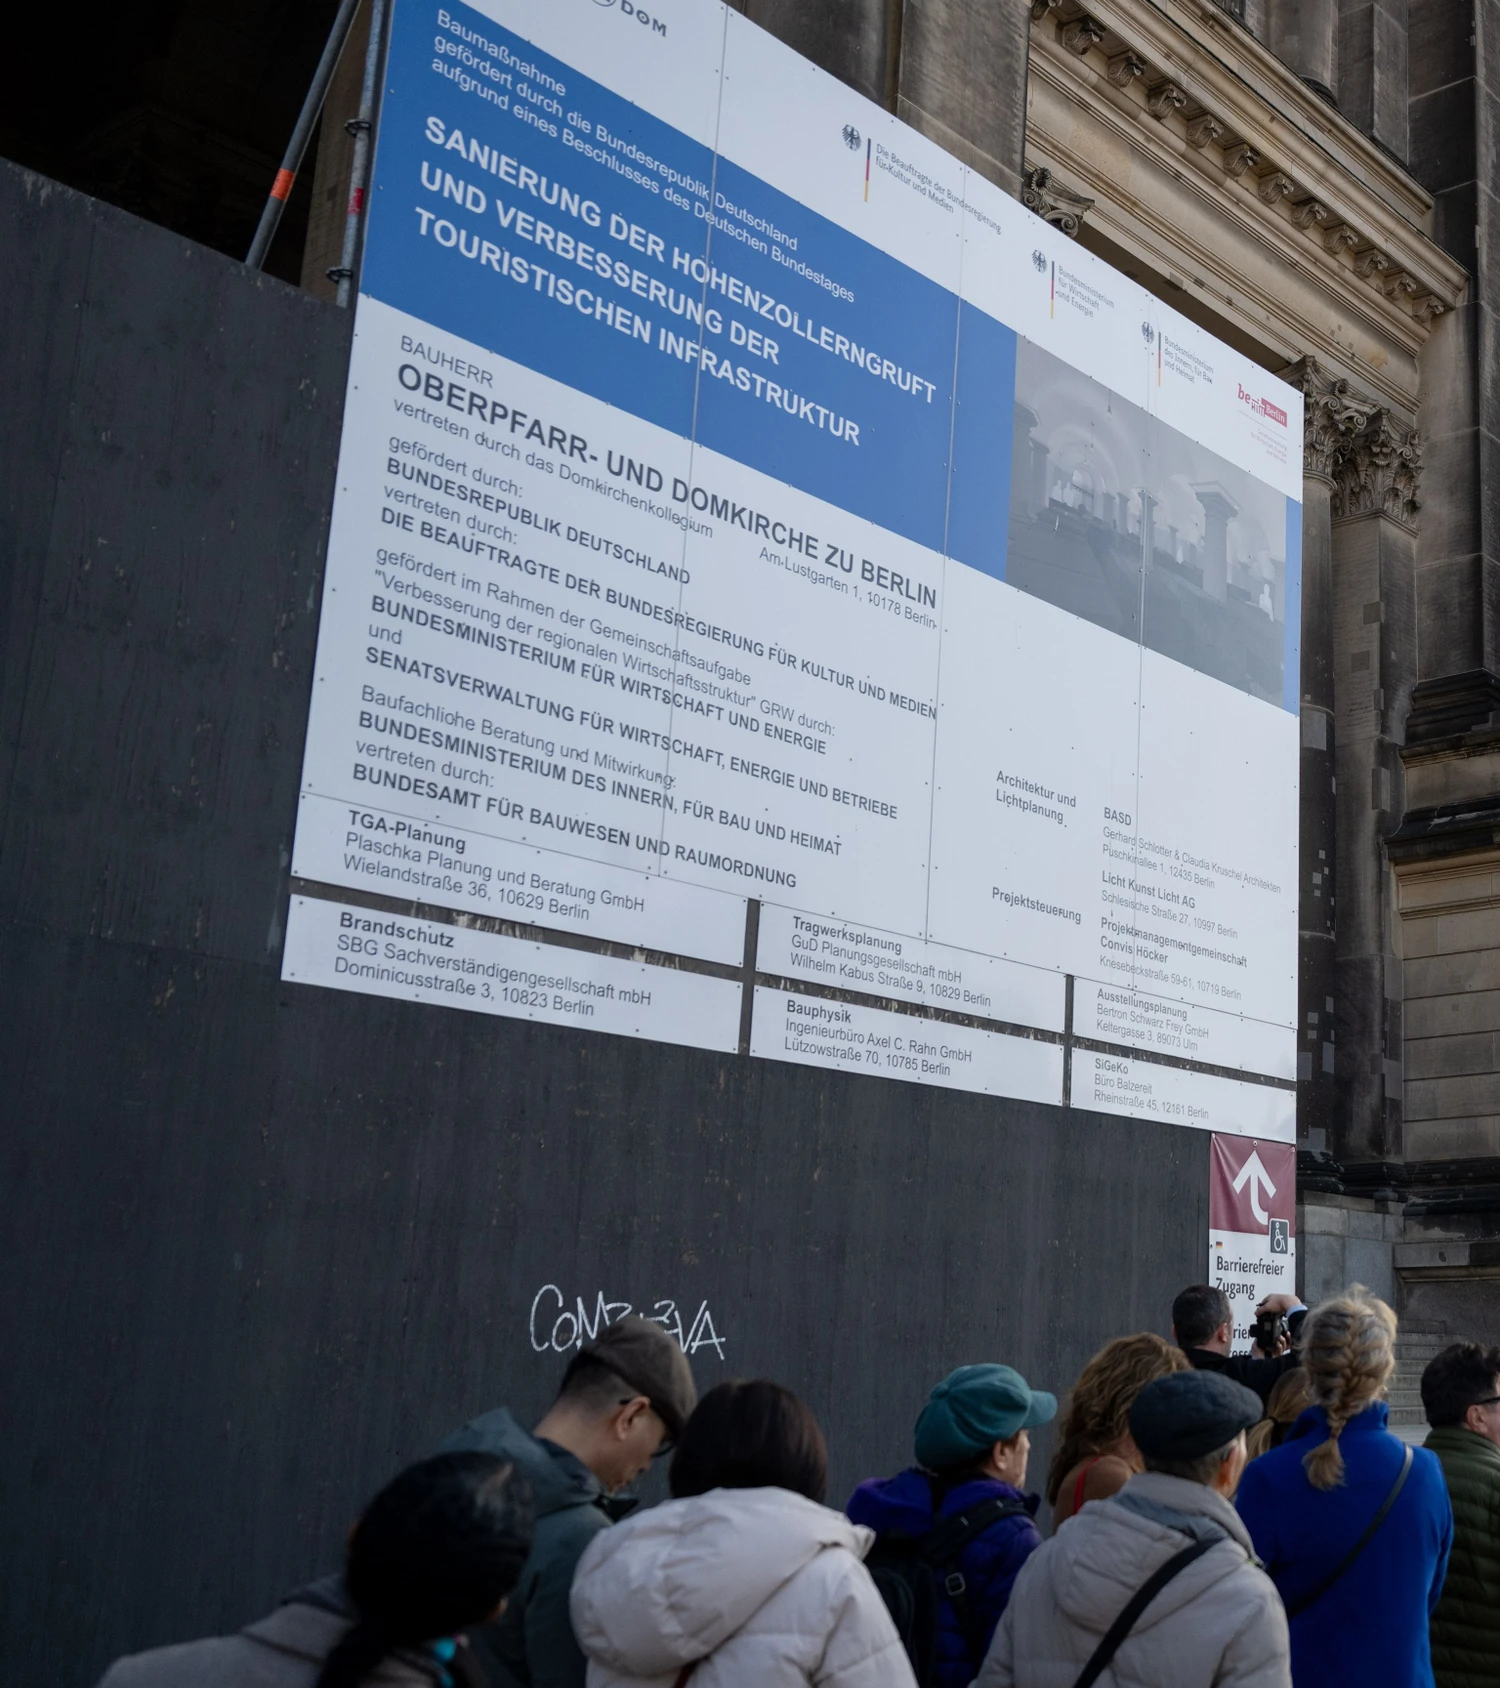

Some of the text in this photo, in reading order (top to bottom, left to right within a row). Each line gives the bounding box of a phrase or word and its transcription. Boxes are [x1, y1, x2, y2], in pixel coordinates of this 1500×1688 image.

[620, 0, 667, 37] DOM
[437, 8, 566, 97] Baumaßnahme
[434, 35, 798, 251] gefördert durch die Bundesrepublik Deutschland
[431, 58, 855, 303] aufgrund eines Beschlusses des Deutschen Bundestages
[875, 155, 954, 214] für Kultur und Medien
[876, 143, 1002, 236] Die Beauftragte der Bundesregierung
[420, 160, 779, 365] UND VERBESSERUNG DER
[425, 116, 937, 404] SANIERUNG DER HOHENZOLLERNGRUFT
[415, 206, 860, 446] TOURISTISCHEN INFRASTRUKTUR
[400, 334, 493, 389] BAUHERR
[1266, 404, 1285, 424] Berlin
[394, 399, 713, 538] vertreten durch das Domkirchenkollegium
[398, 363, 936, 609] OBERPFARR- UND DOMKIRCHE ZU BERLIN
[387, 457, 690, 585] BUNDESREPUBLIK DEUTSCHLAND
[381, 506, 935, 719] DIE BEAUFTRAGTE DER BUNDESREGIERUNG FÜR KULTUR UND MEDIEN
[759, 546, 936, 630] Am Lustgarten 1, 10178 Berlin
[368, 624, 403, 645] und
[376, 548, 751, 686] gefördert im Rahmen der Gemeinschaftsaufgabe
[371, 594, 826, 755] BUNDESMINISTERIUM FÜR WIRTSCHAFT UND ENERGIE
[374, 569, 835, 737] "Verbesserung der regionalen Wirtschaftsstruktur" GRW durch:
[361, 684, 677, 790] Baufachliche Beratung und Mitwirkung:
[366, 646, 898, 820] SENATSVERWALTUNG FÜR WIRTSCHAFT, ENERGIE UND BETRIEBE
[359, 710, 842, 856] BUNDESMINISTERIUM DES INNERN, FÜR BAU UND HEIMAT
[996, 770, 1077, 808] Architektur und
[996, 788, 1064, 825] Lichtplanung
[348, 809, 466, 855] TGA-Planung
[353, 762, 796, 888] BUNDESAMT FÜR BAUWESEN UND RAUMORDNUNG
[1103, 806, 1132, 826] BASD
[345, 831, 645, 912] Plaschka Planung und Beratung GmbH
[1102, 843, 1158, 871] Puschkinallee
[1169, 865, 1193, 882] 12435
[1193, 872, 1215, 889] Berlin
[1102, 870, 1196, 909] Licht Kunst Licht AG
[340, 911, 455, 948] Brandschutz
[992, 886, 1082, 925] Projektsteuerung
[791, 934, 962, 984] GuD Planungsgesellschaft mbH
[793, 915, 902, 956] Tragwerksplanung
[1100, 916, 1248, 968] Projektmanagementgemeinschaft
[1100, 935, 1169, 964] Convis Höcker
[337, 933, 650, 1005] SBG Sachverständigengesellschaft mbH
[790, 951, 991, 1007] Wilhelm Kabus Straße 9, 10829 Berlin
[786, 999, 852, 1024] Bauphysik
[1096, 987, 1188, 1022] Ausstellungsplanung
[1096, 1002, 1209, 1039] Bertron Schwarz Frey GmbH
[785, 1017, 972, 1063] Ingenieurbüro Axel C. Rahn GmbH
[1094, 1057, 1129, 1075] SiGeKo
[1094, 1073, 1153, 1095] Büro Balzereit
[1215, 1278, 1256, 1300] Zugang
[1217, 1256, 1284, 1276] Barrierefreier
